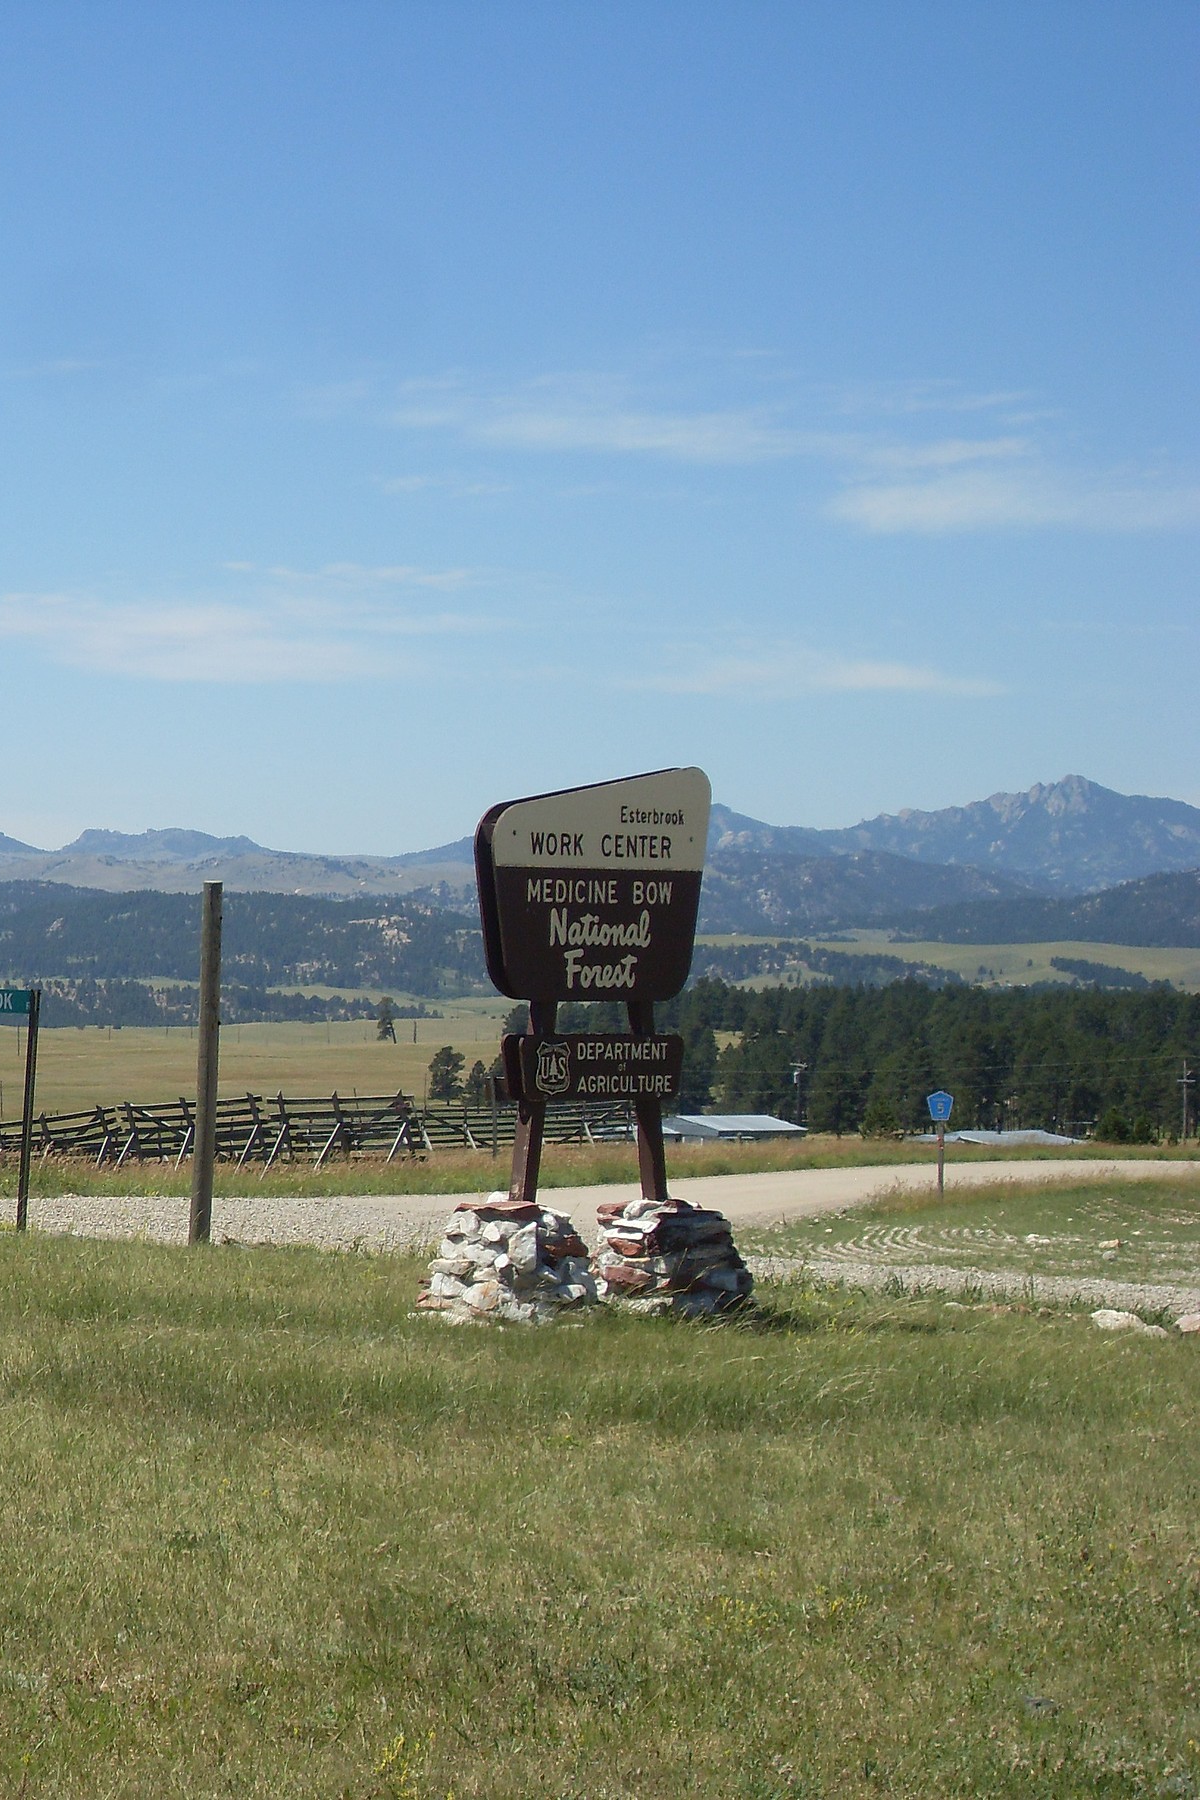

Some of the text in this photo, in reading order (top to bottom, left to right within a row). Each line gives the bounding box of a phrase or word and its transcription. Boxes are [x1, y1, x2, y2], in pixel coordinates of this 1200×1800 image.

[620, 806, 685, 825] Esterbrook
[530, 832, 672, 859] WORK CENTER
[527, 879, 674, 905] MEDICINE BOW
[549, 907, 651, 948] National
[564, 948, 638, 989] Forest
[577, 1042, 668, 1061] DEPARTMENT
[541, 1056, 567, 1080] US
[577, 1074, 673, 1094] AGRICULTURE
[937, 1103, 945, 1114] 5
